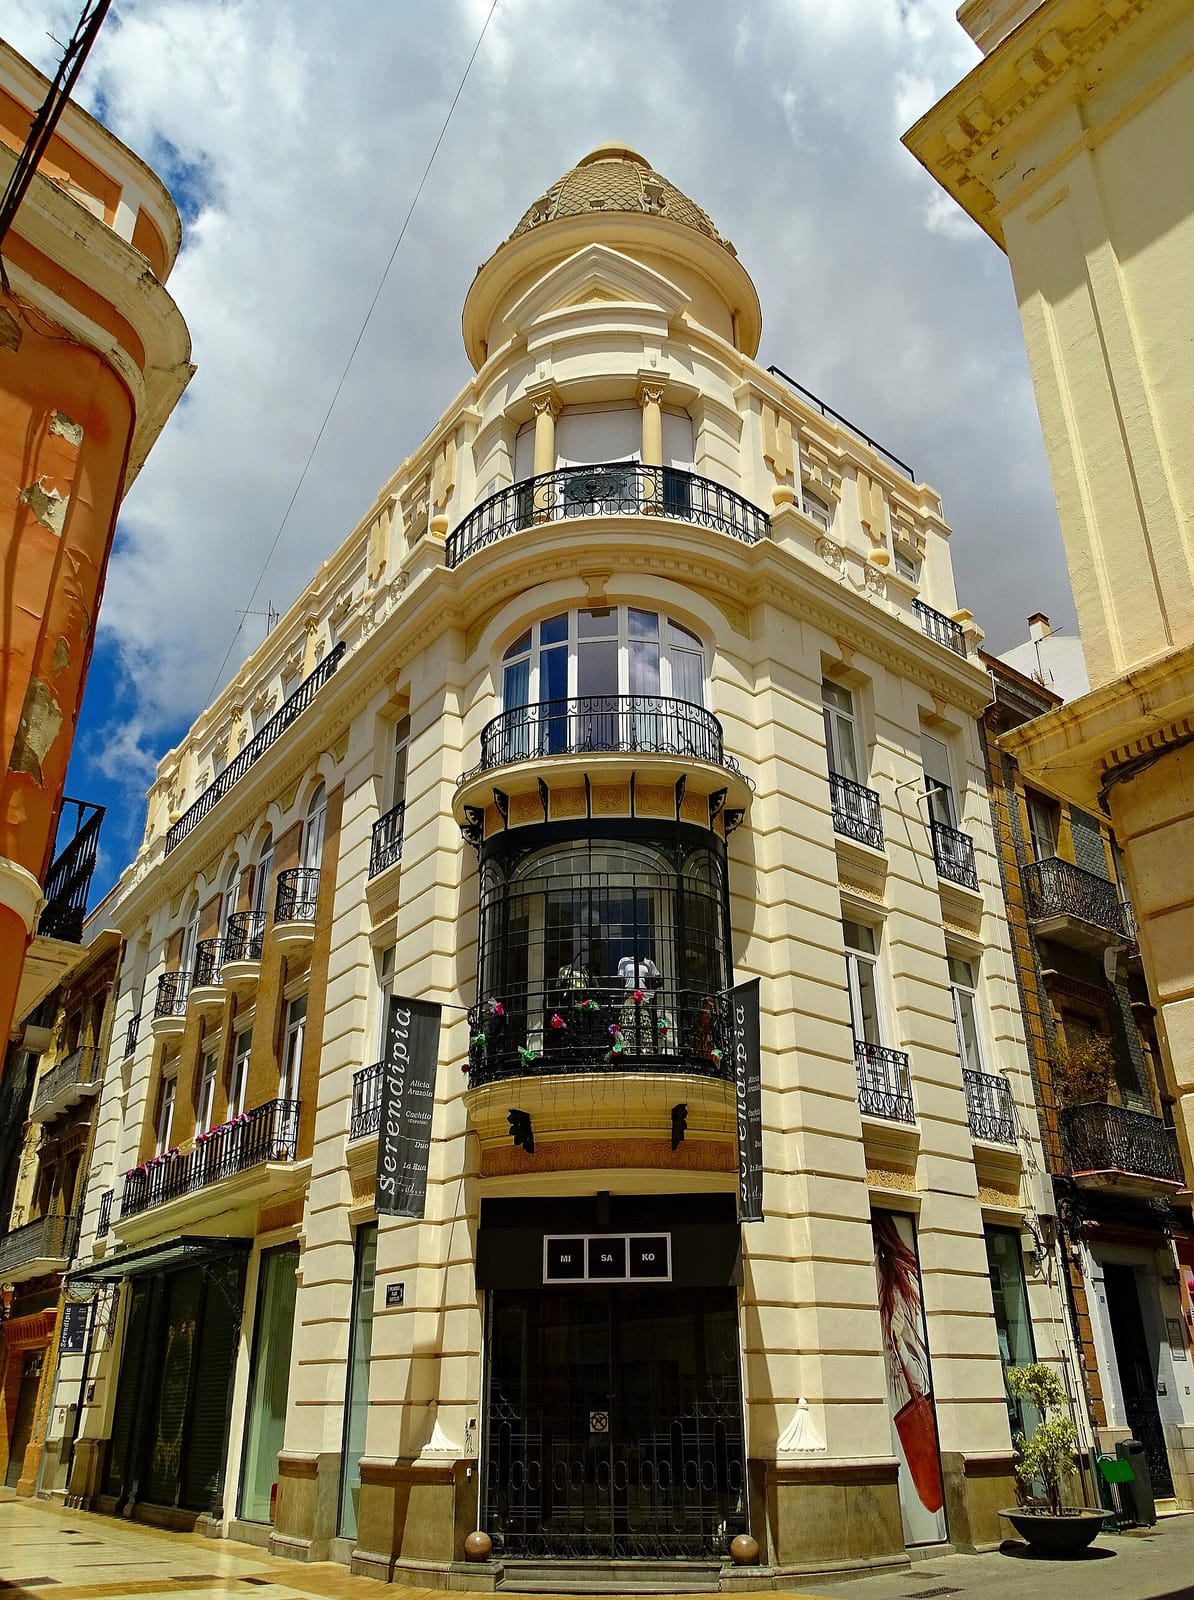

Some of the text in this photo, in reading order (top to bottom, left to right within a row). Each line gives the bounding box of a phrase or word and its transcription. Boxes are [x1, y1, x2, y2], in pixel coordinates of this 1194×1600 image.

[409, 1079, 431, 1089] Alicia
[379, 1006, 412, 1196] Serendipia
[414, 1141, 429, 1150] Duo
[560, 1253, 655, 1263] MI SA KO
